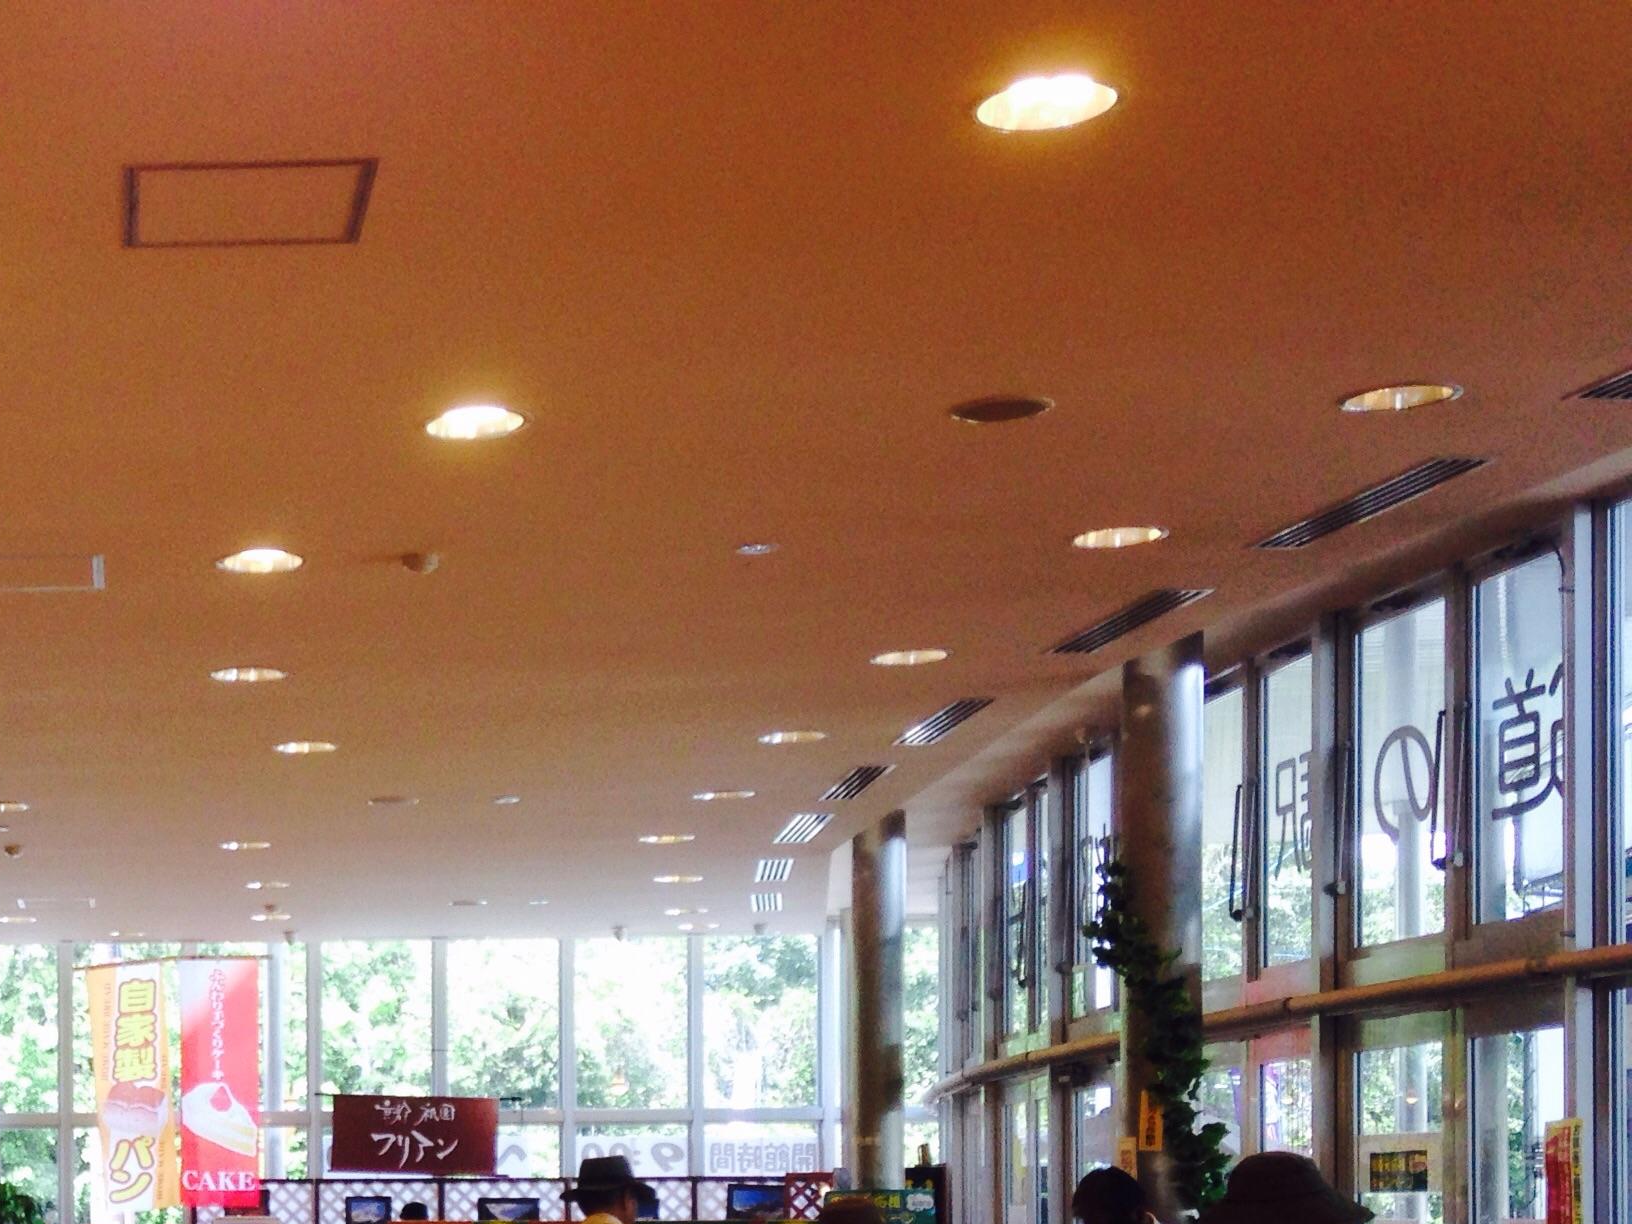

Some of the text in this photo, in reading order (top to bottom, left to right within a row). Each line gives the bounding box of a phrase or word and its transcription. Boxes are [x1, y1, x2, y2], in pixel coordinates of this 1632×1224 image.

[109, 978, 158, 1204] 自家製 パン
[181, 1170, 256, 1193] CAKE
